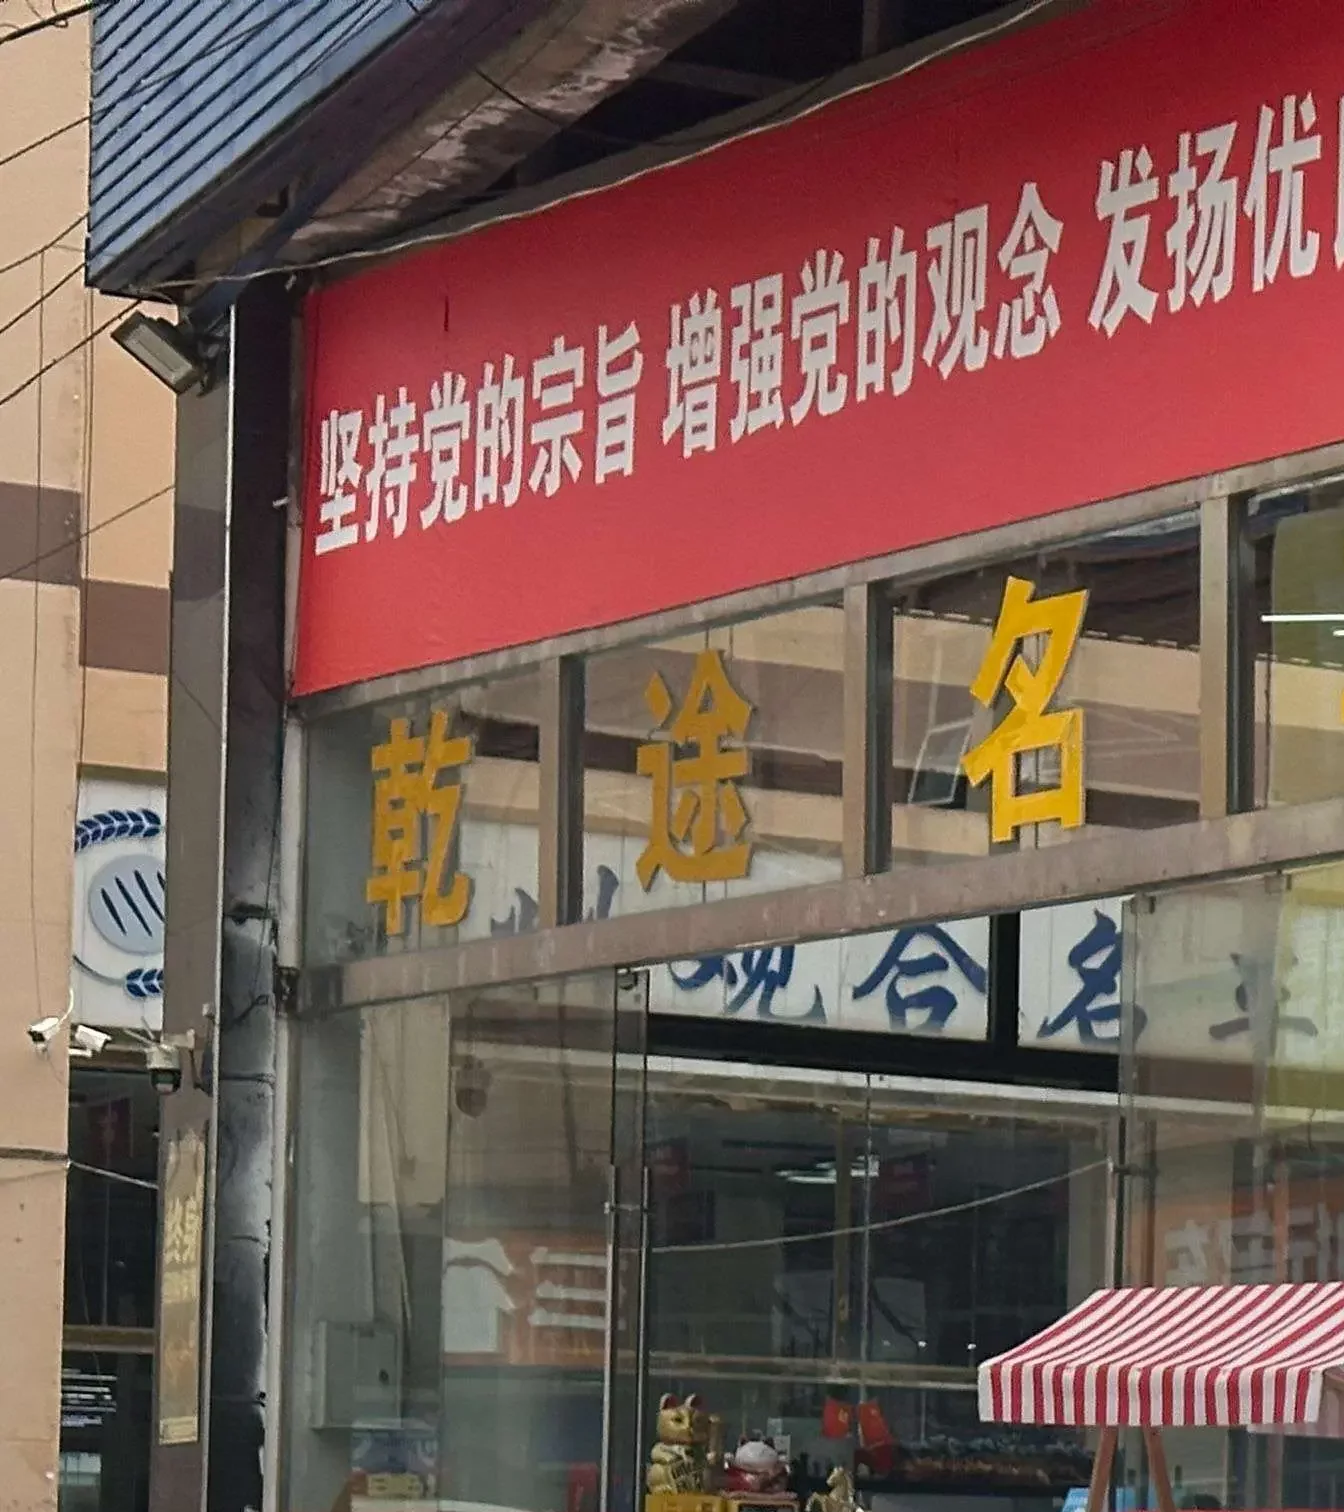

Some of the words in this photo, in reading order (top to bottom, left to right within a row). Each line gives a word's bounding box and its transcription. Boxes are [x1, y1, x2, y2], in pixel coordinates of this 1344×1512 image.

[314, 320, 644, 557] 坚持党的宗旨
[662, 182, 1065, 459] 增强党的观念
